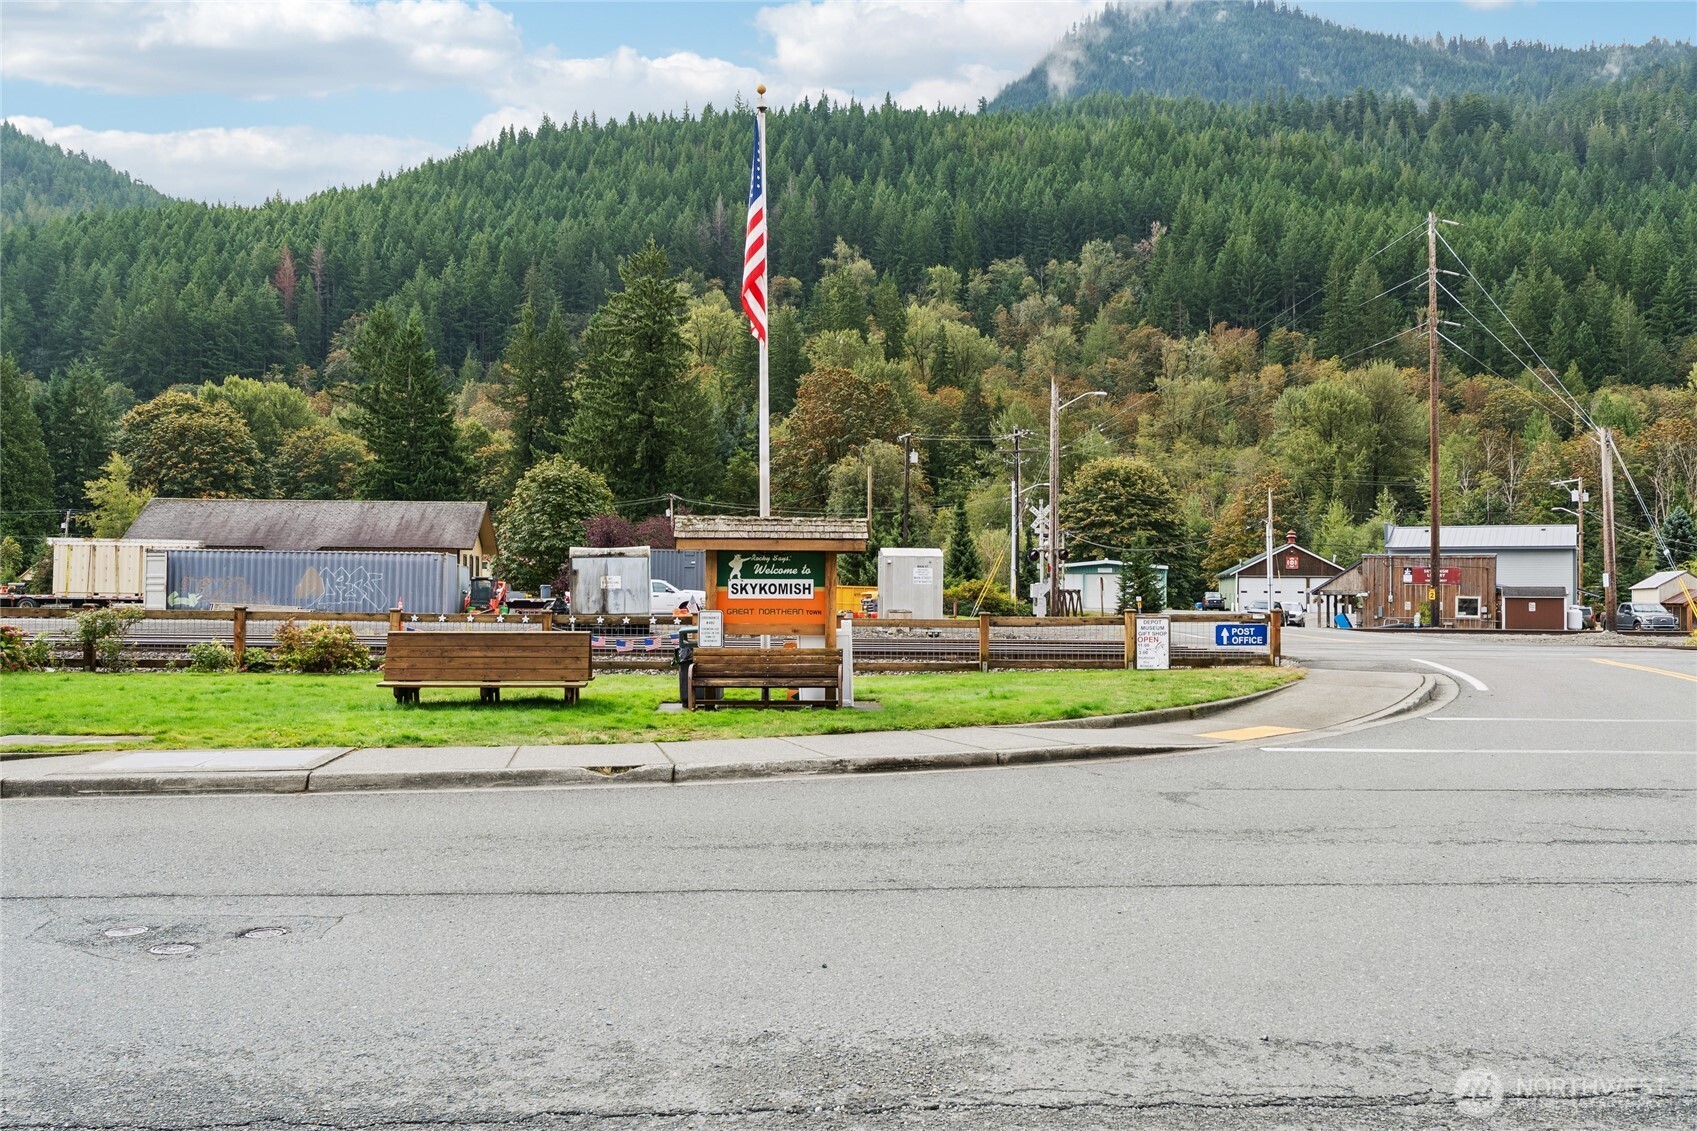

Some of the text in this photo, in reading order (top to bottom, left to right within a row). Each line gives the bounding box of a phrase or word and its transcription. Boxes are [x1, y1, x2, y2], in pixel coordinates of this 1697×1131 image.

[753, 563, 811, 575] Welcome to
[730, 582, 812, 595] SKYKOMISH
[1231, 627, 1255, 635] POST
[1231, 636, 1263, 644] OFFICE
